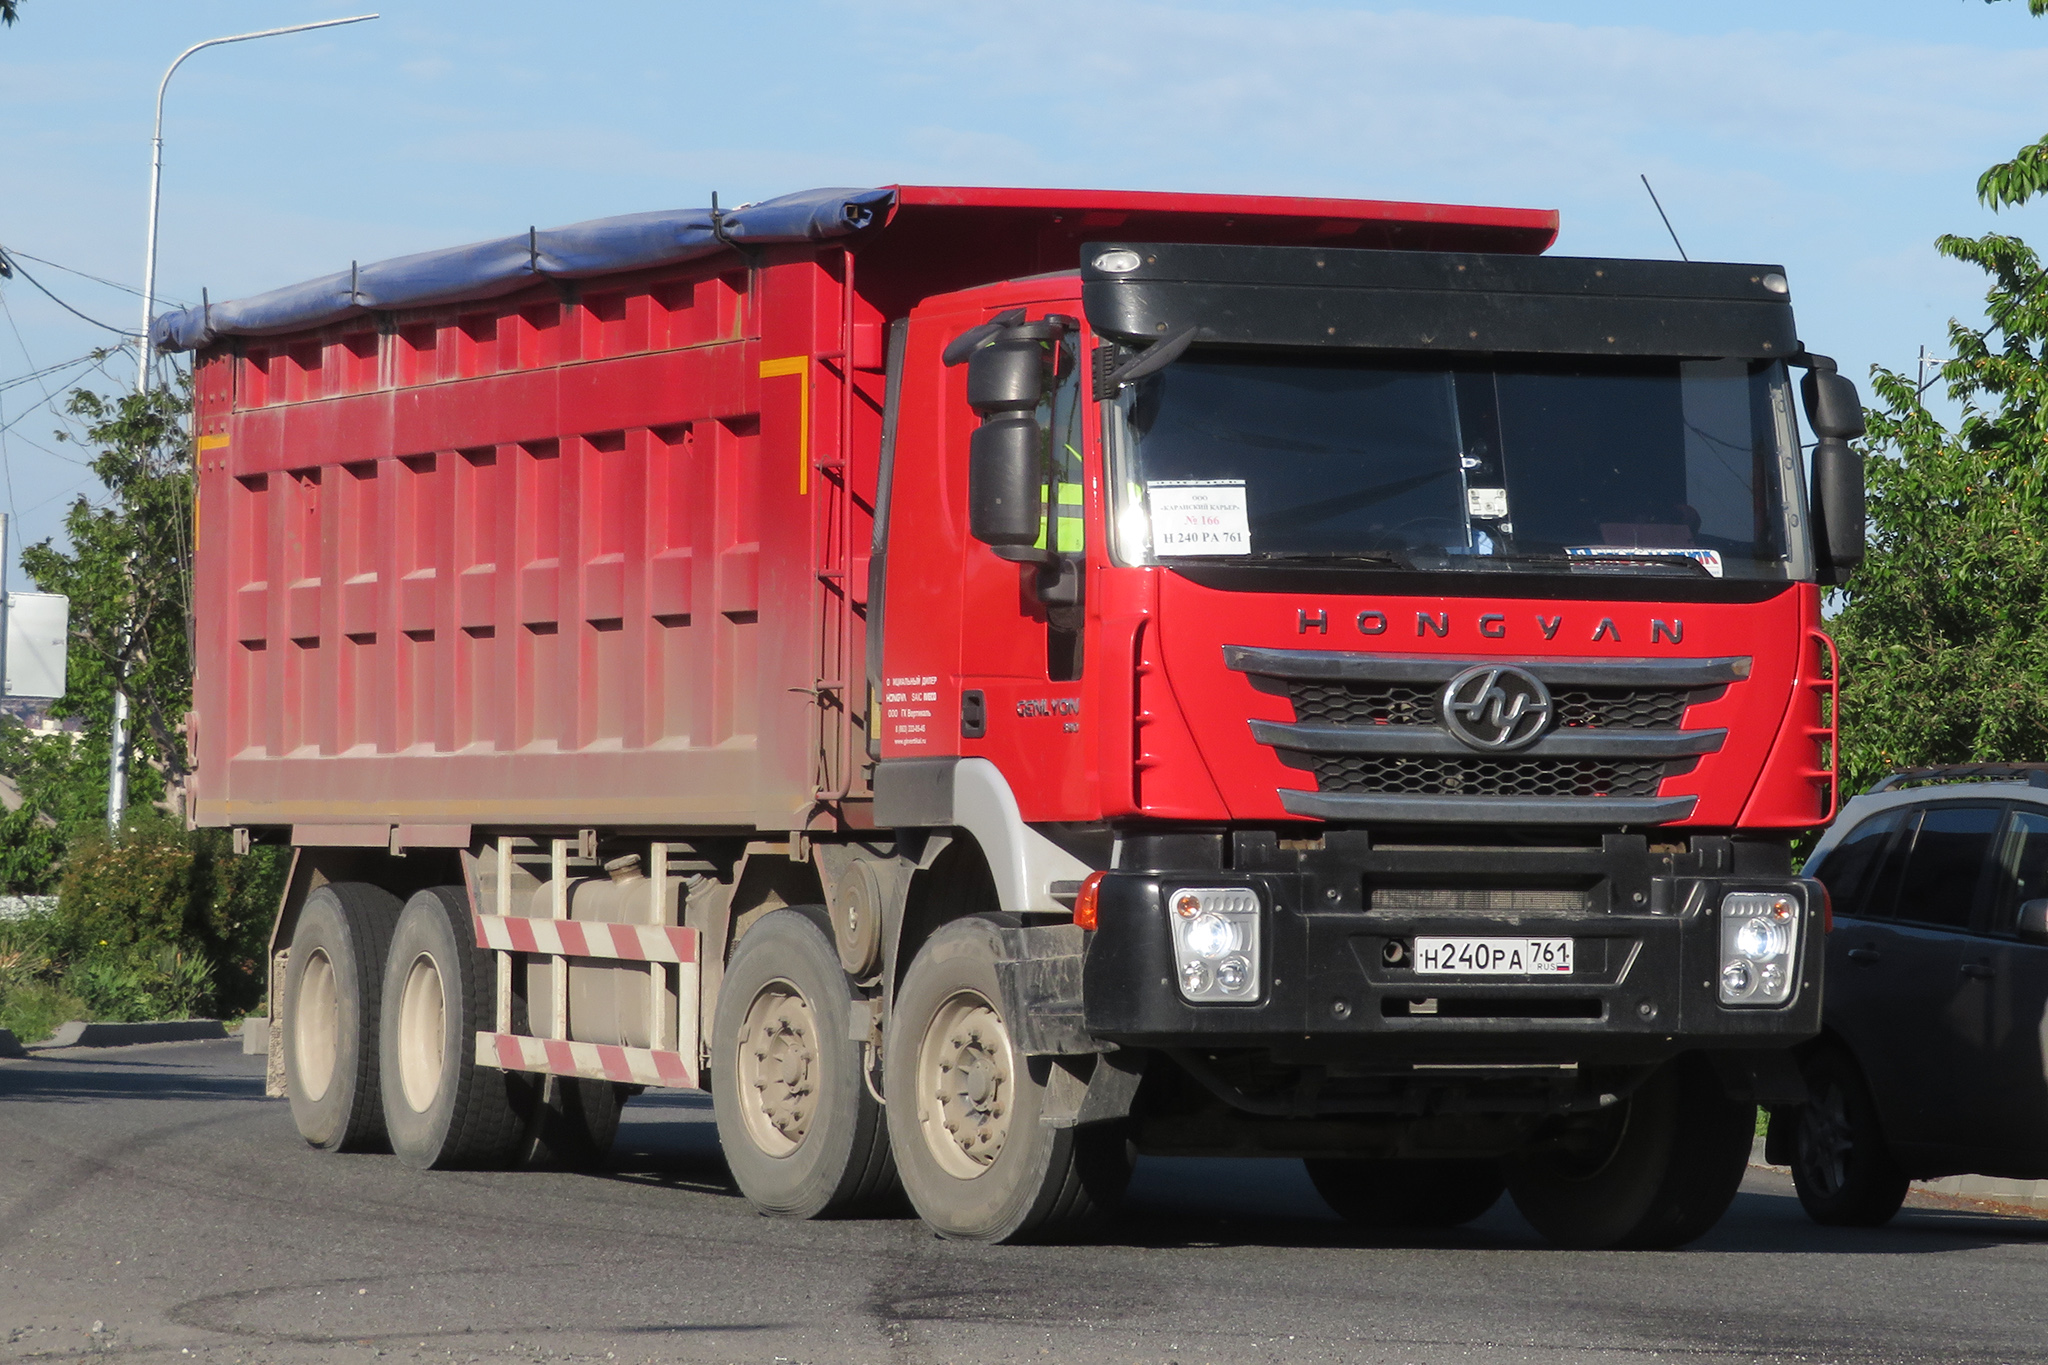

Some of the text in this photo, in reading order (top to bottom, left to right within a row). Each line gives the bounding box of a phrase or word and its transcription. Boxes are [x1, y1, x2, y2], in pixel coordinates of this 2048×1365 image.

[1201, 515, 1220, 526] 166
[1178, 532, 1199, 543] 240
[1202, 532, 1219, 543] РА
[1223, 532, 1242, 543] 761
[1297, 608, 1684, 645] HONGYAN
[1016, 698, 1080, 717] GENLYON
[1530, 942, 1567, 963] 761
[1536, 962, 1557, 971] RUS
